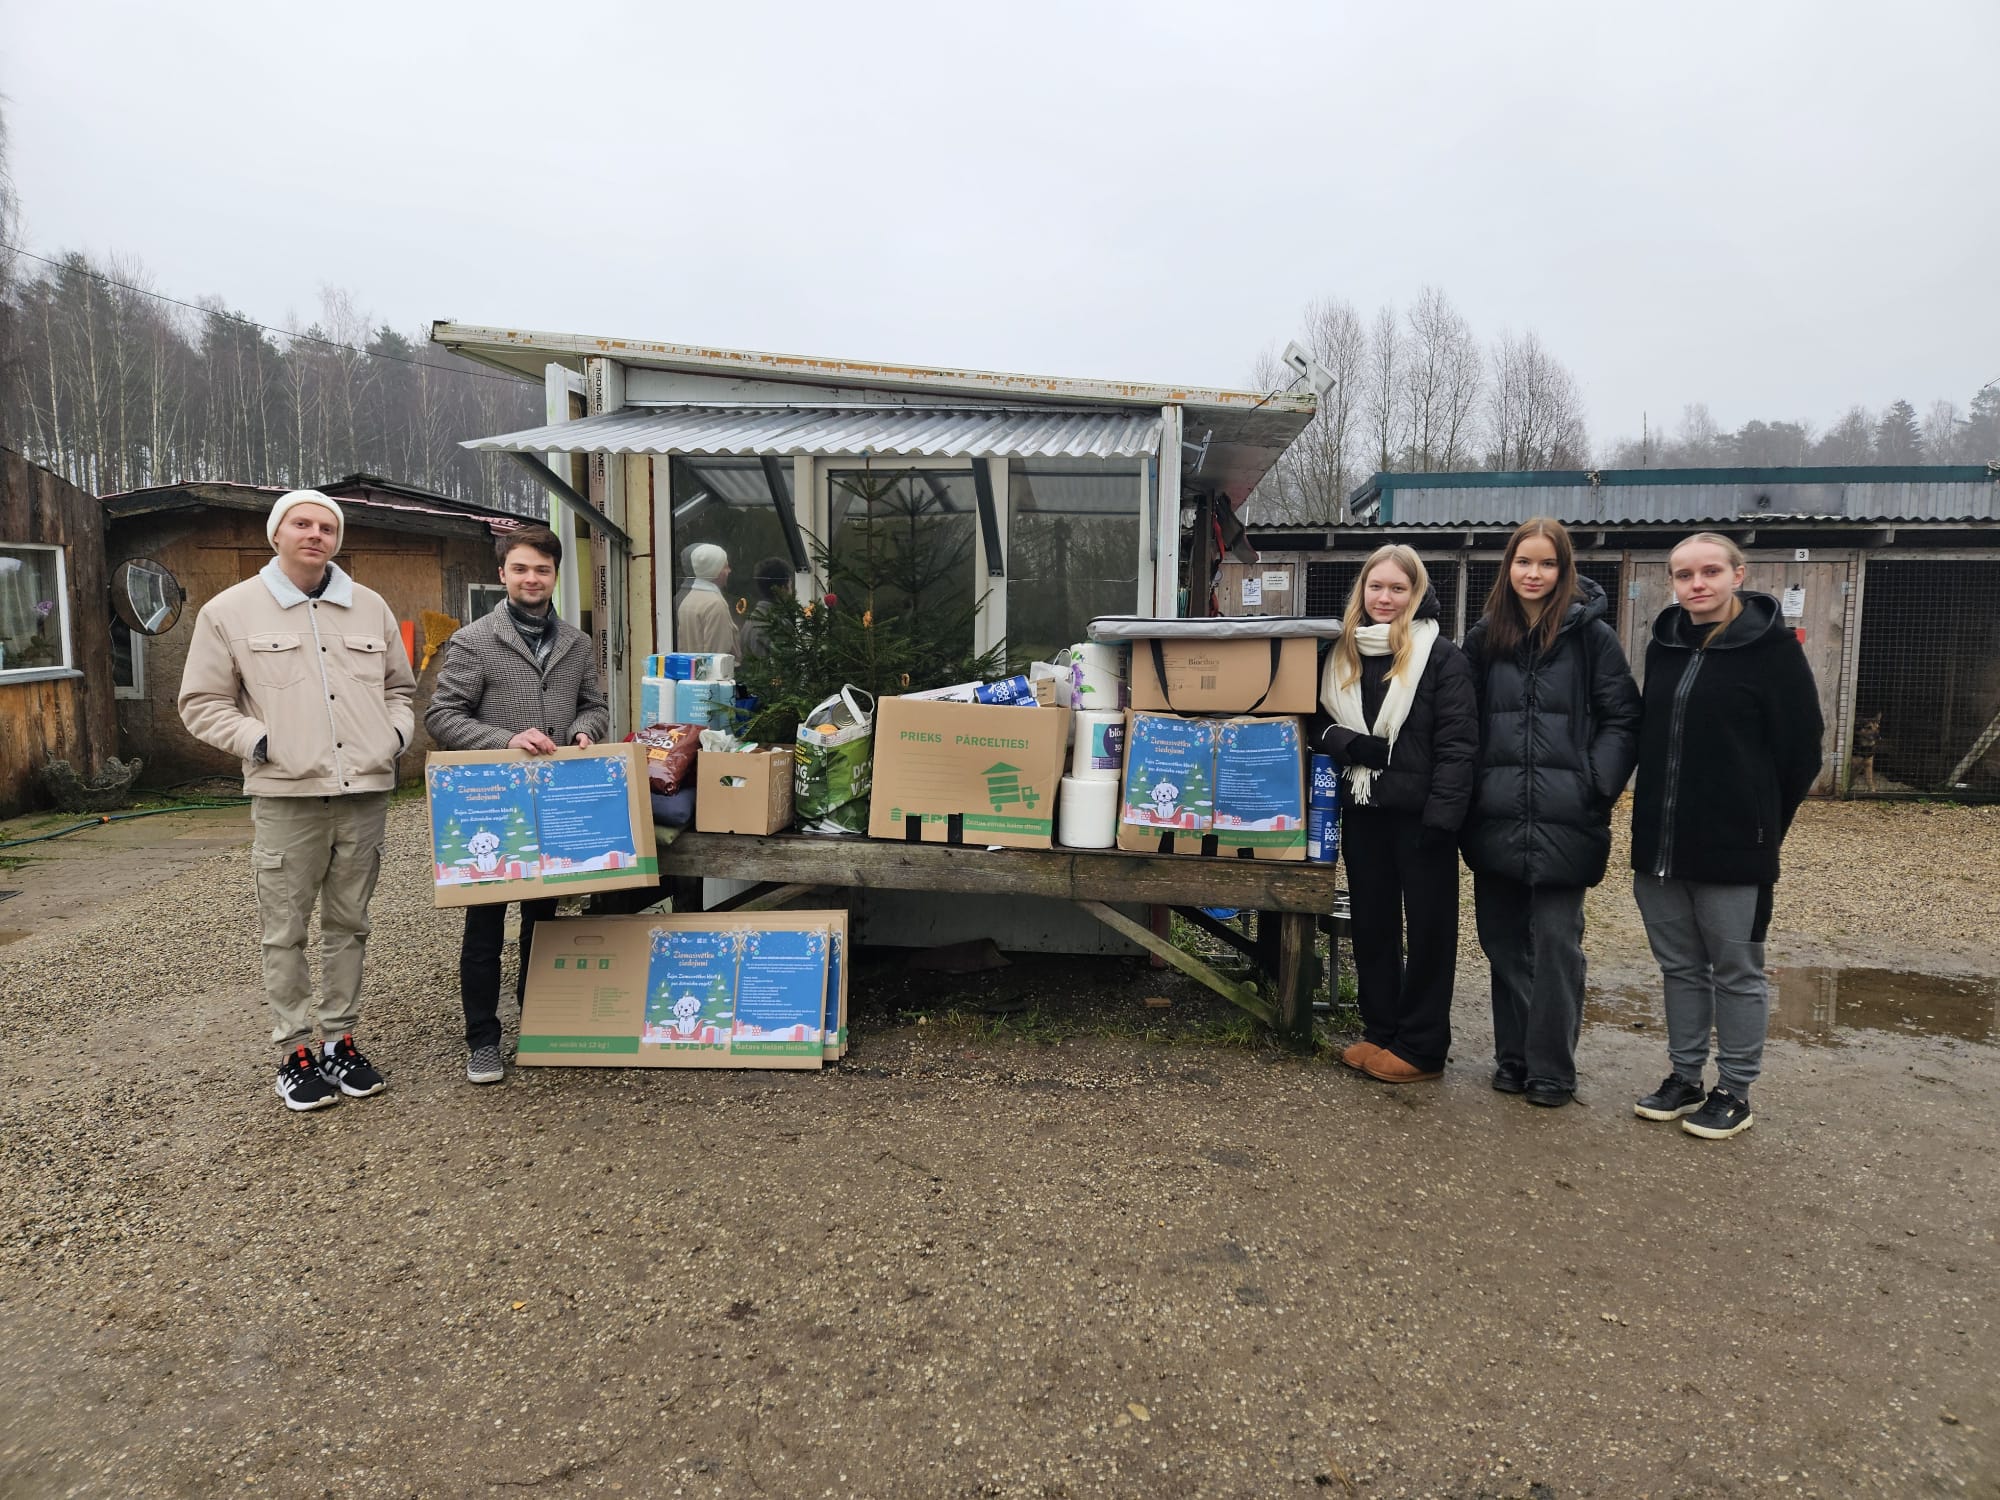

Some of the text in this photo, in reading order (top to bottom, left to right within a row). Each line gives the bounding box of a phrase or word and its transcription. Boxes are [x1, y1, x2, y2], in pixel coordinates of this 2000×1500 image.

[1799, 551, 1806, 559] 3
[900, 731, 942, 743] PRIEKS
[1314, 773, 1332, 781] DOG
